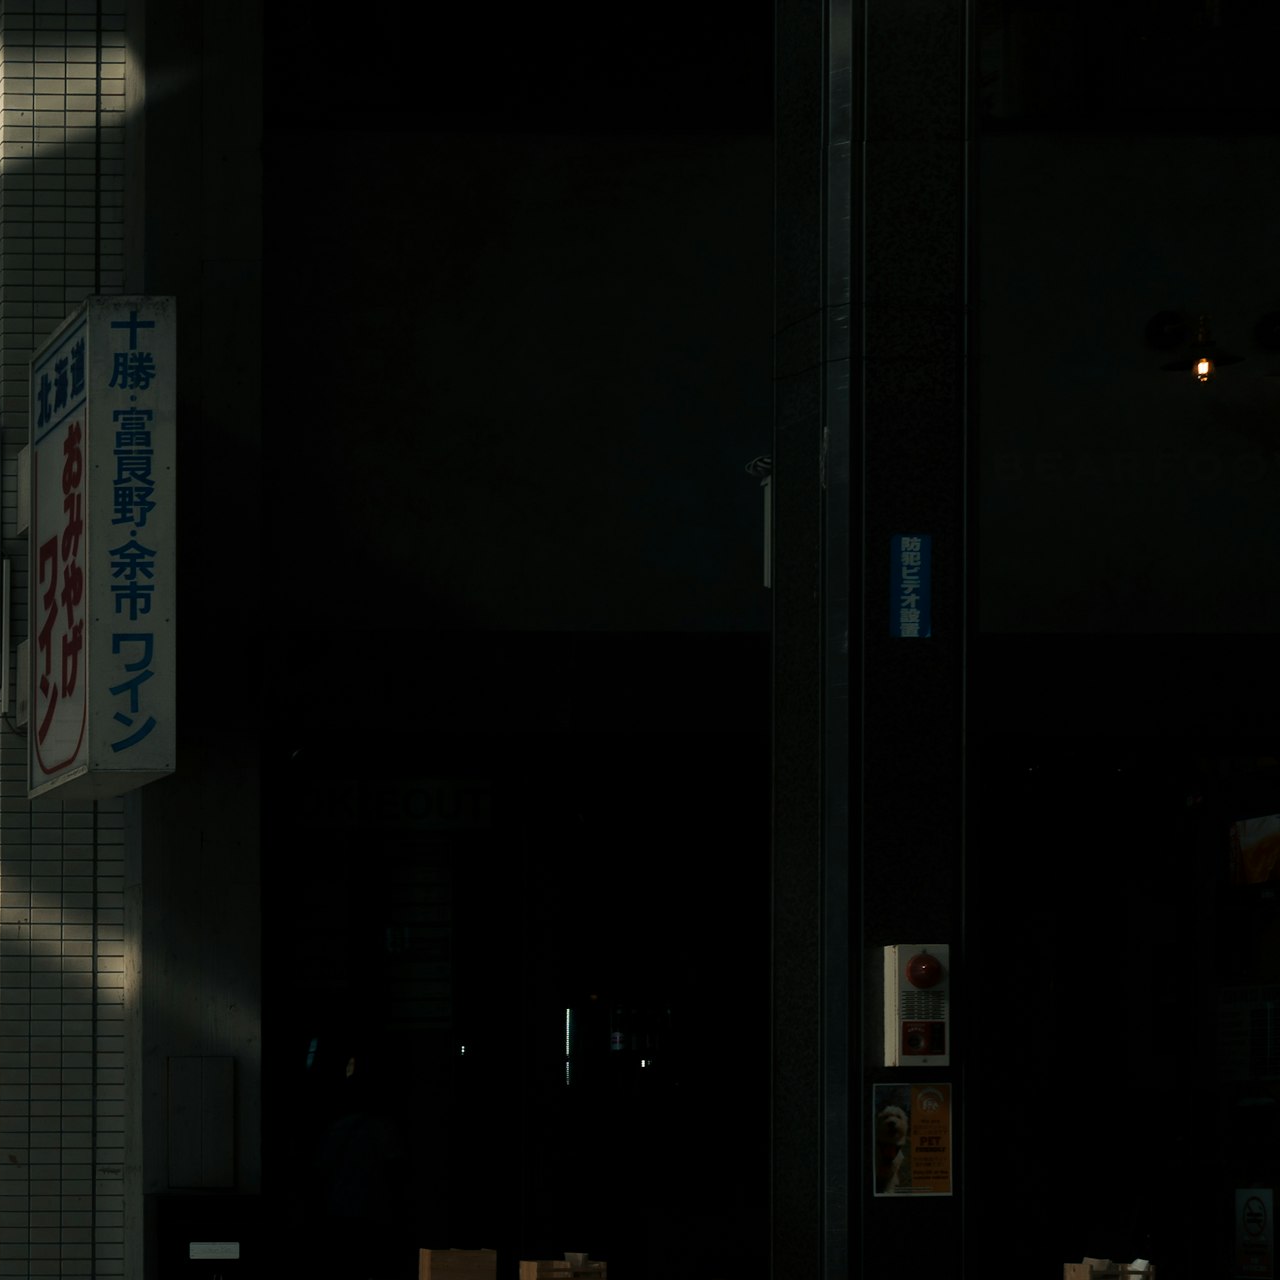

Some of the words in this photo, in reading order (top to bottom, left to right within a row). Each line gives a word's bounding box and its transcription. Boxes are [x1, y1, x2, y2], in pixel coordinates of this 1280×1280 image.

[37, 337, 85, 428] 北海道
[38, 534, 58, 746] ワイン
[61, 420, 84, 699] おみやげ
[108, 632, 157, 753] ワイン
